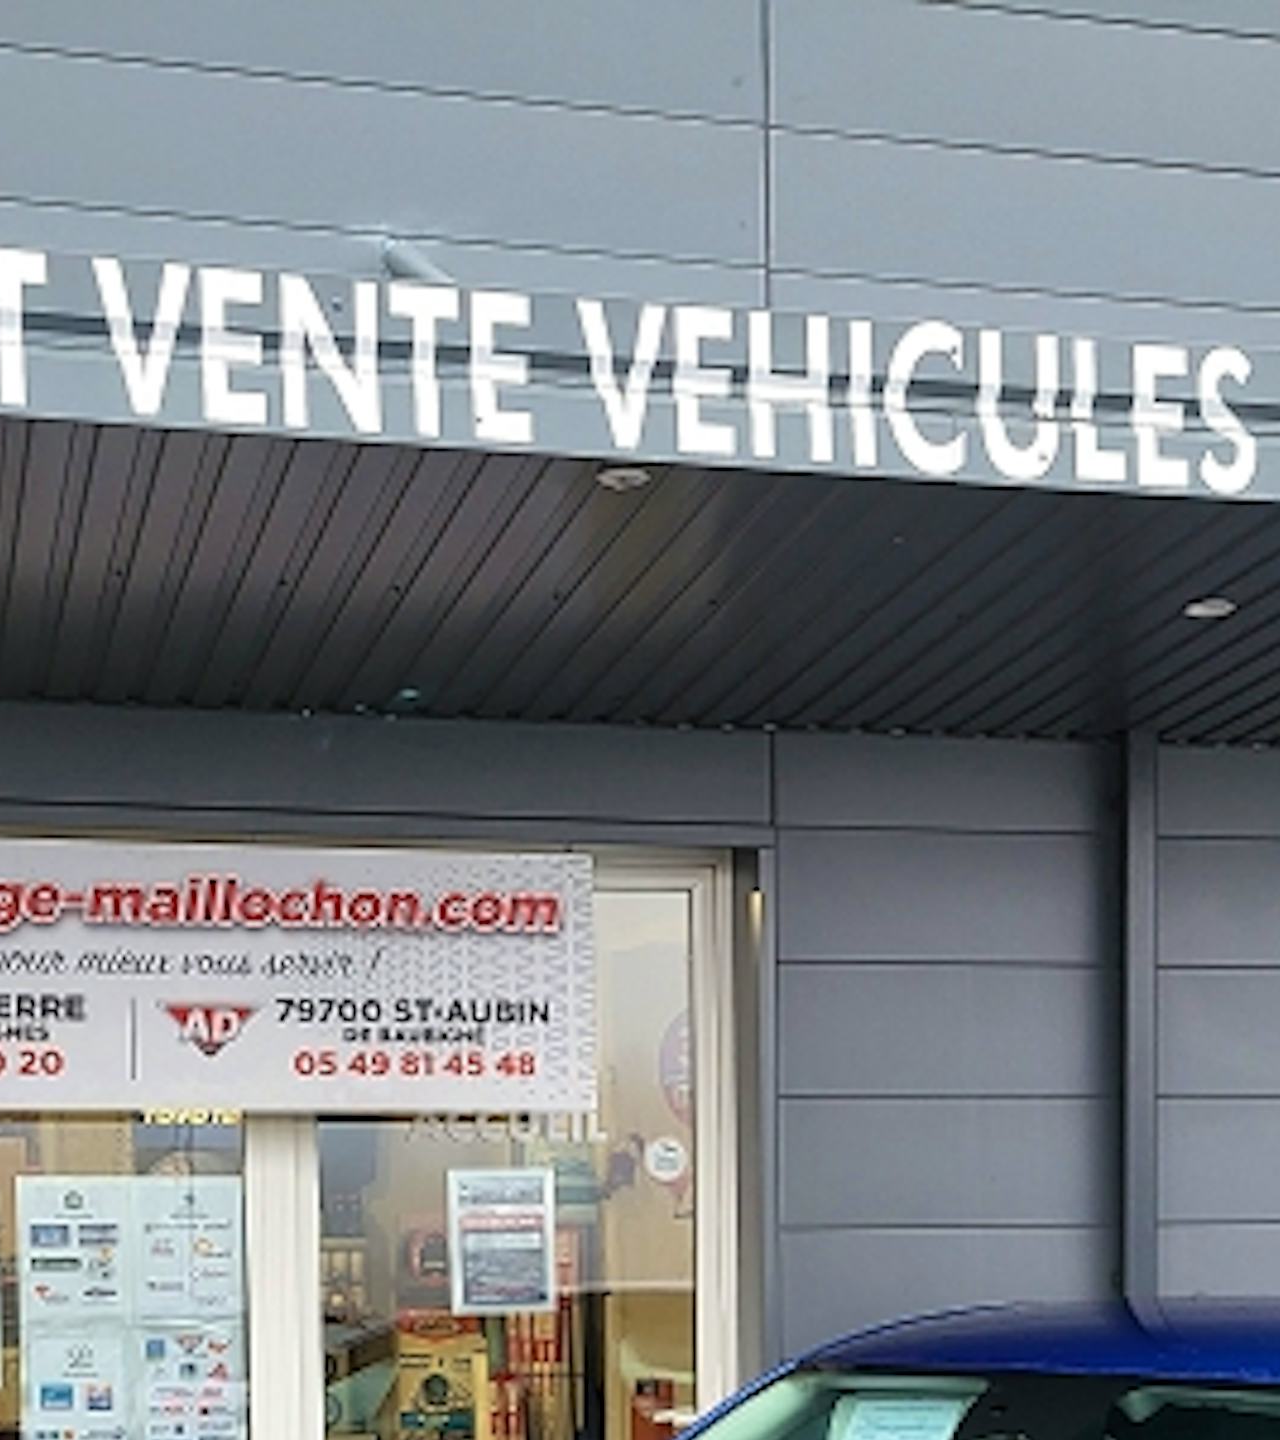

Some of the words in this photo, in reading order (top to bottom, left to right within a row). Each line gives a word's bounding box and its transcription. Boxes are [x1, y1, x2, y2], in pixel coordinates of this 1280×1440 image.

[91, 256, 533, 444] VENTE
[577, 296, 1257, 495] VEHICULES
[182, 950, 252, 976] vous
[275, 999, 382, 1024] 79700
[394, 999, 551, 1024] ST-AUBIN
[20, 1050, 64, 1076] 20
[293, 1051, 339, 1076] 05
[349, 1051, 390, 1076] 49
[400, 1051, 434, 1077] 81
[444, 1052, 486, 1077] 45
[496, 1052, 537, 1077] 48
